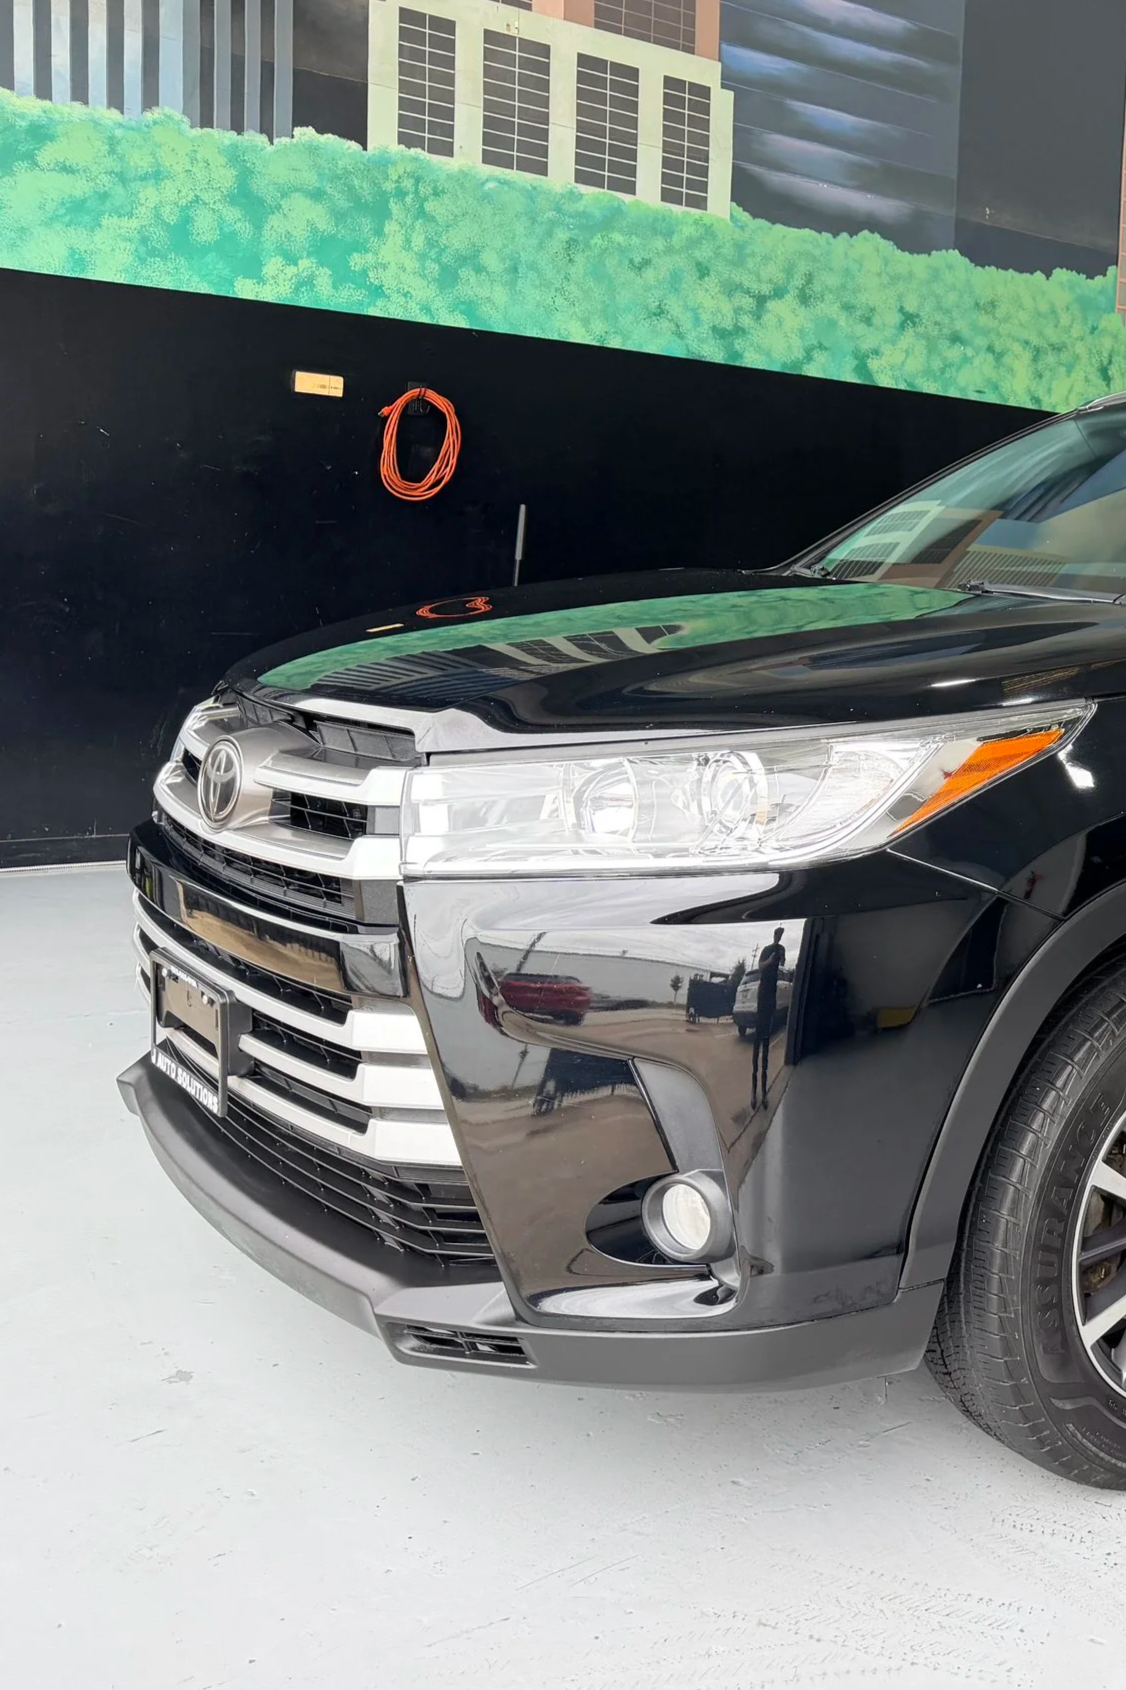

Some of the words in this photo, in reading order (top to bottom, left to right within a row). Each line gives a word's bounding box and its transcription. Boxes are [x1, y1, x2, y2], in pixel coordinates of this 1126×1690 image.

[156, 1052, 177, 1080] AUTO
[177, 1067, 219, 1114] SOLUTIONS
[1037, 1092, 1112, 1356] ASSURANCE
